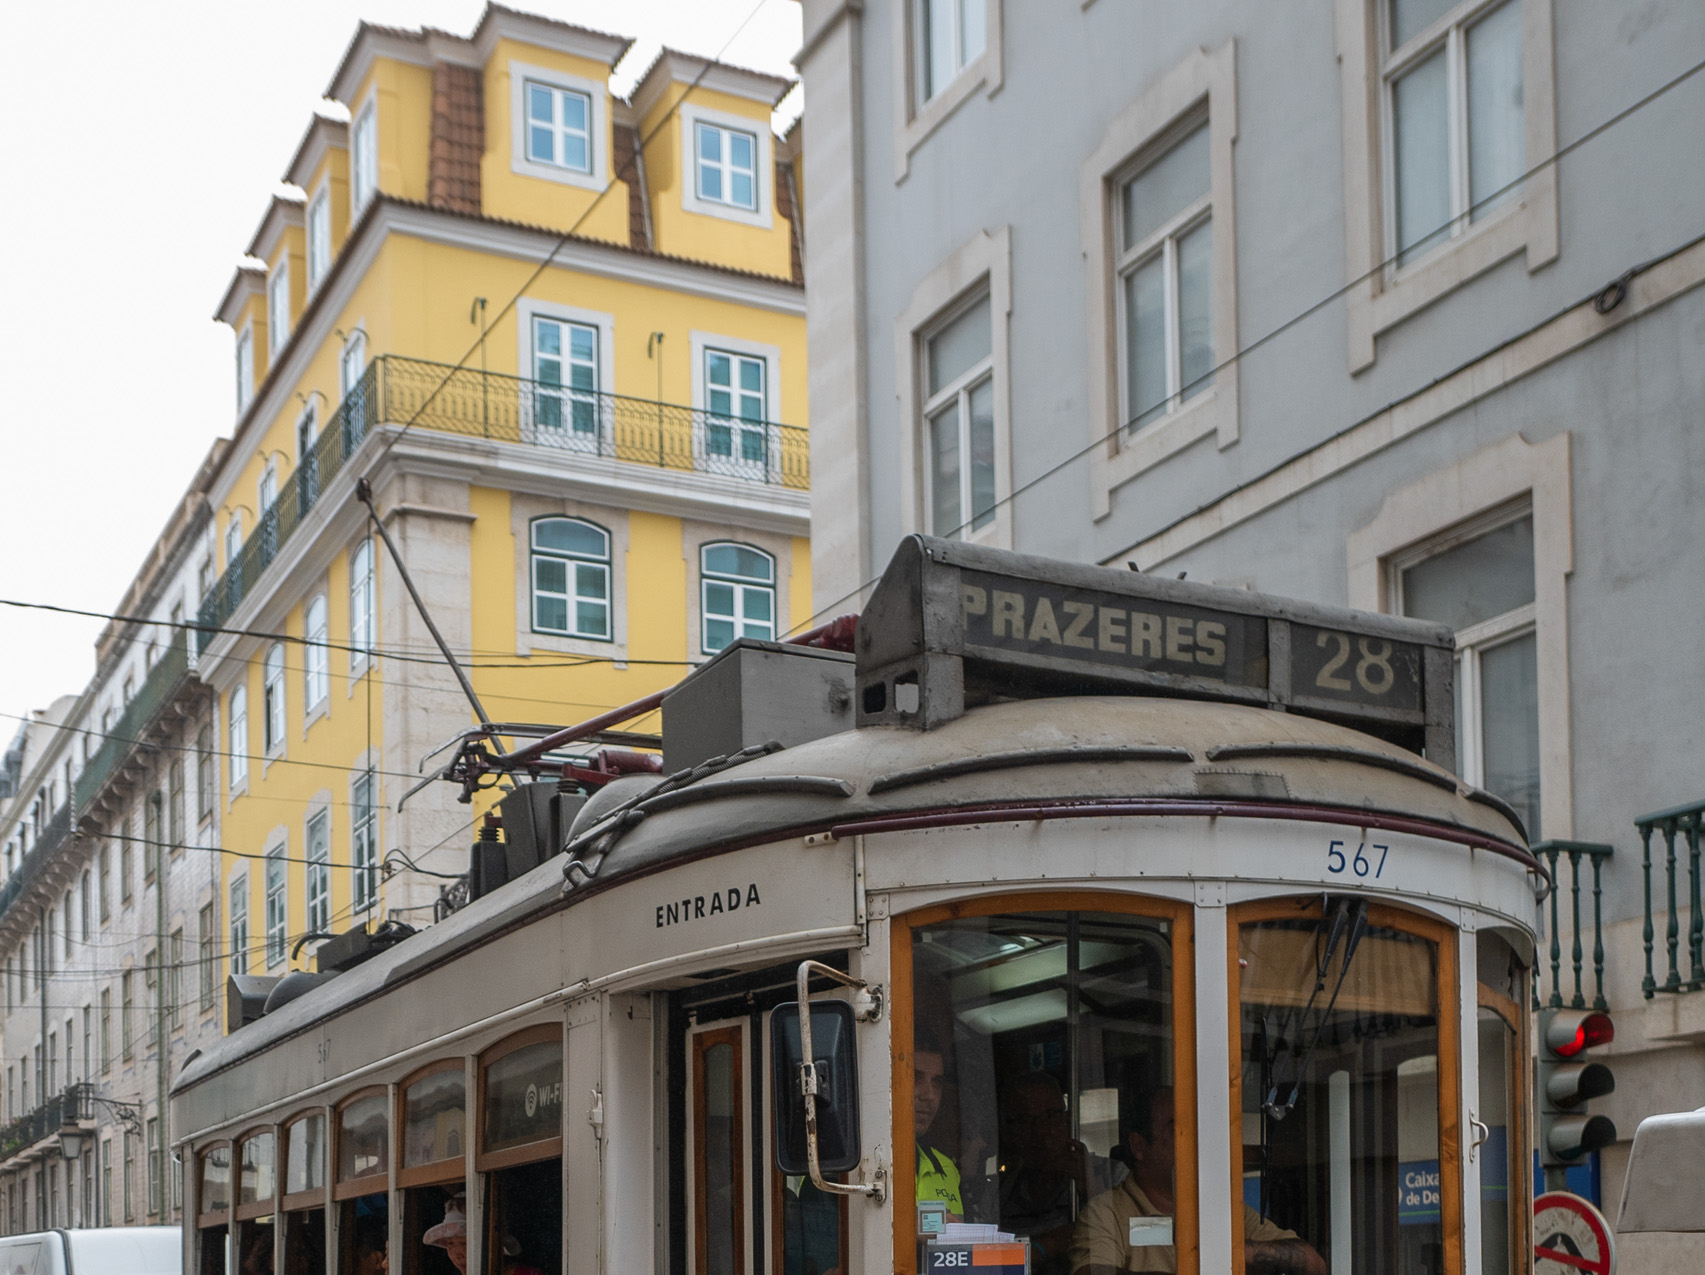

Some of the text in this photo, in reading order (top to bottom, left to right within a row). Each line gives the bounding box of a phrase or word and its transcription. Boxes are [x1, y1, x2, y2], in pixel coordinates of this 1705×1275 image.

[960, 583, 1226, 667] PRAZERES
[1316, 630, 1394, 694] 28
[1328, 840, 1389, 878] 567
[656, 883, 761, 928] ENTRADA
[1406, 1191, 1420, 1206] de
[934, 1251, 969, 1268] 28E
